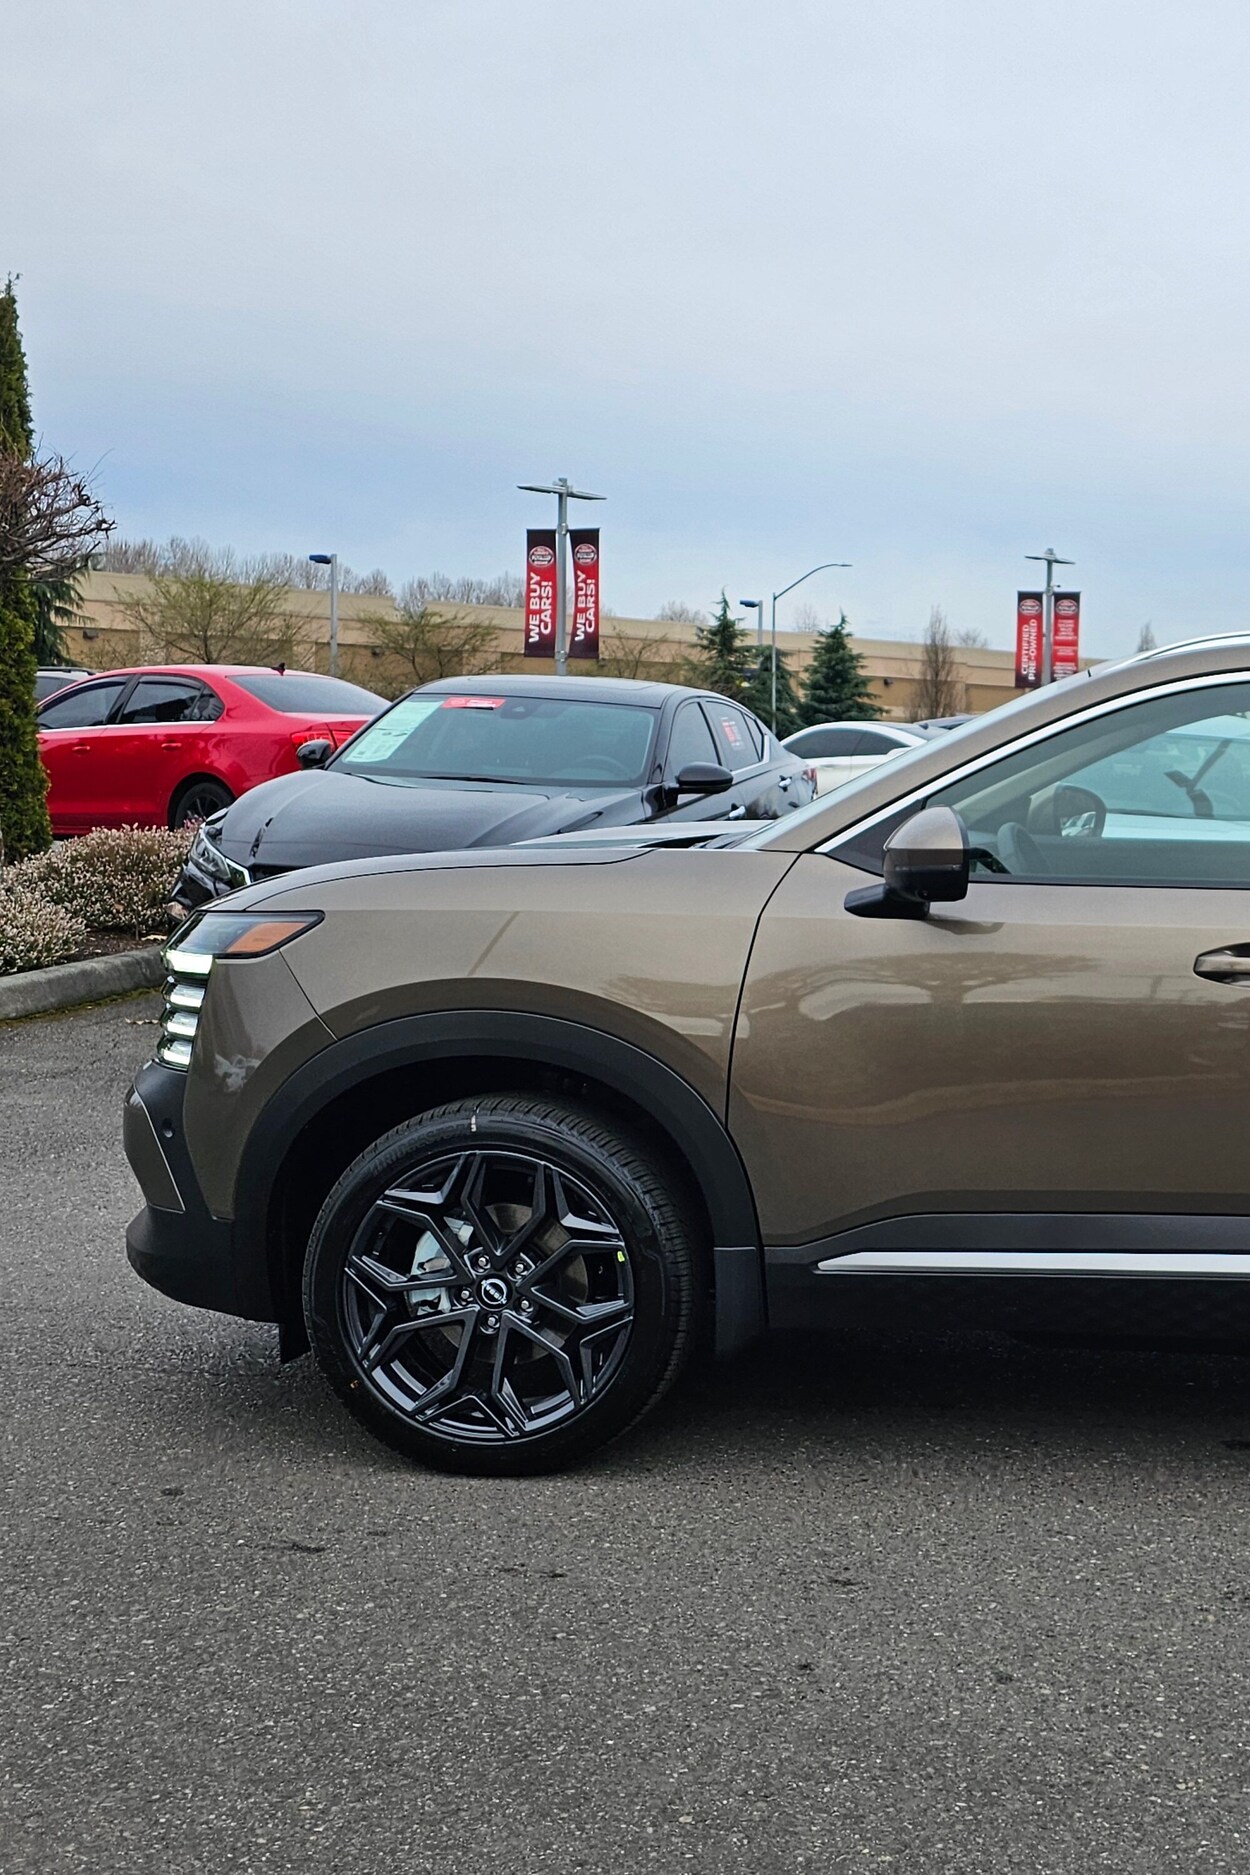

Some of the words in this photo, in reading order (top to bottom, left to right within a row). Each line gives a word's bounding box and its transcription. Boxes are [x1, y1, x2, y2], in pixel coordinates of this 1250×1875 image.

[529, 571, 541, 610] BUY
[540, 581, 552, 635] CARS!
[576, 569, 587, 608] BUY
[585, 579, 596, 633] CARS!
[528, 614, 540, 643] WE
[574, 612, 586, 641] WE
[1028, 618, 1038, 680] PRE-OWNED
[1021, 624, 1030, 675] CERTIFIED
